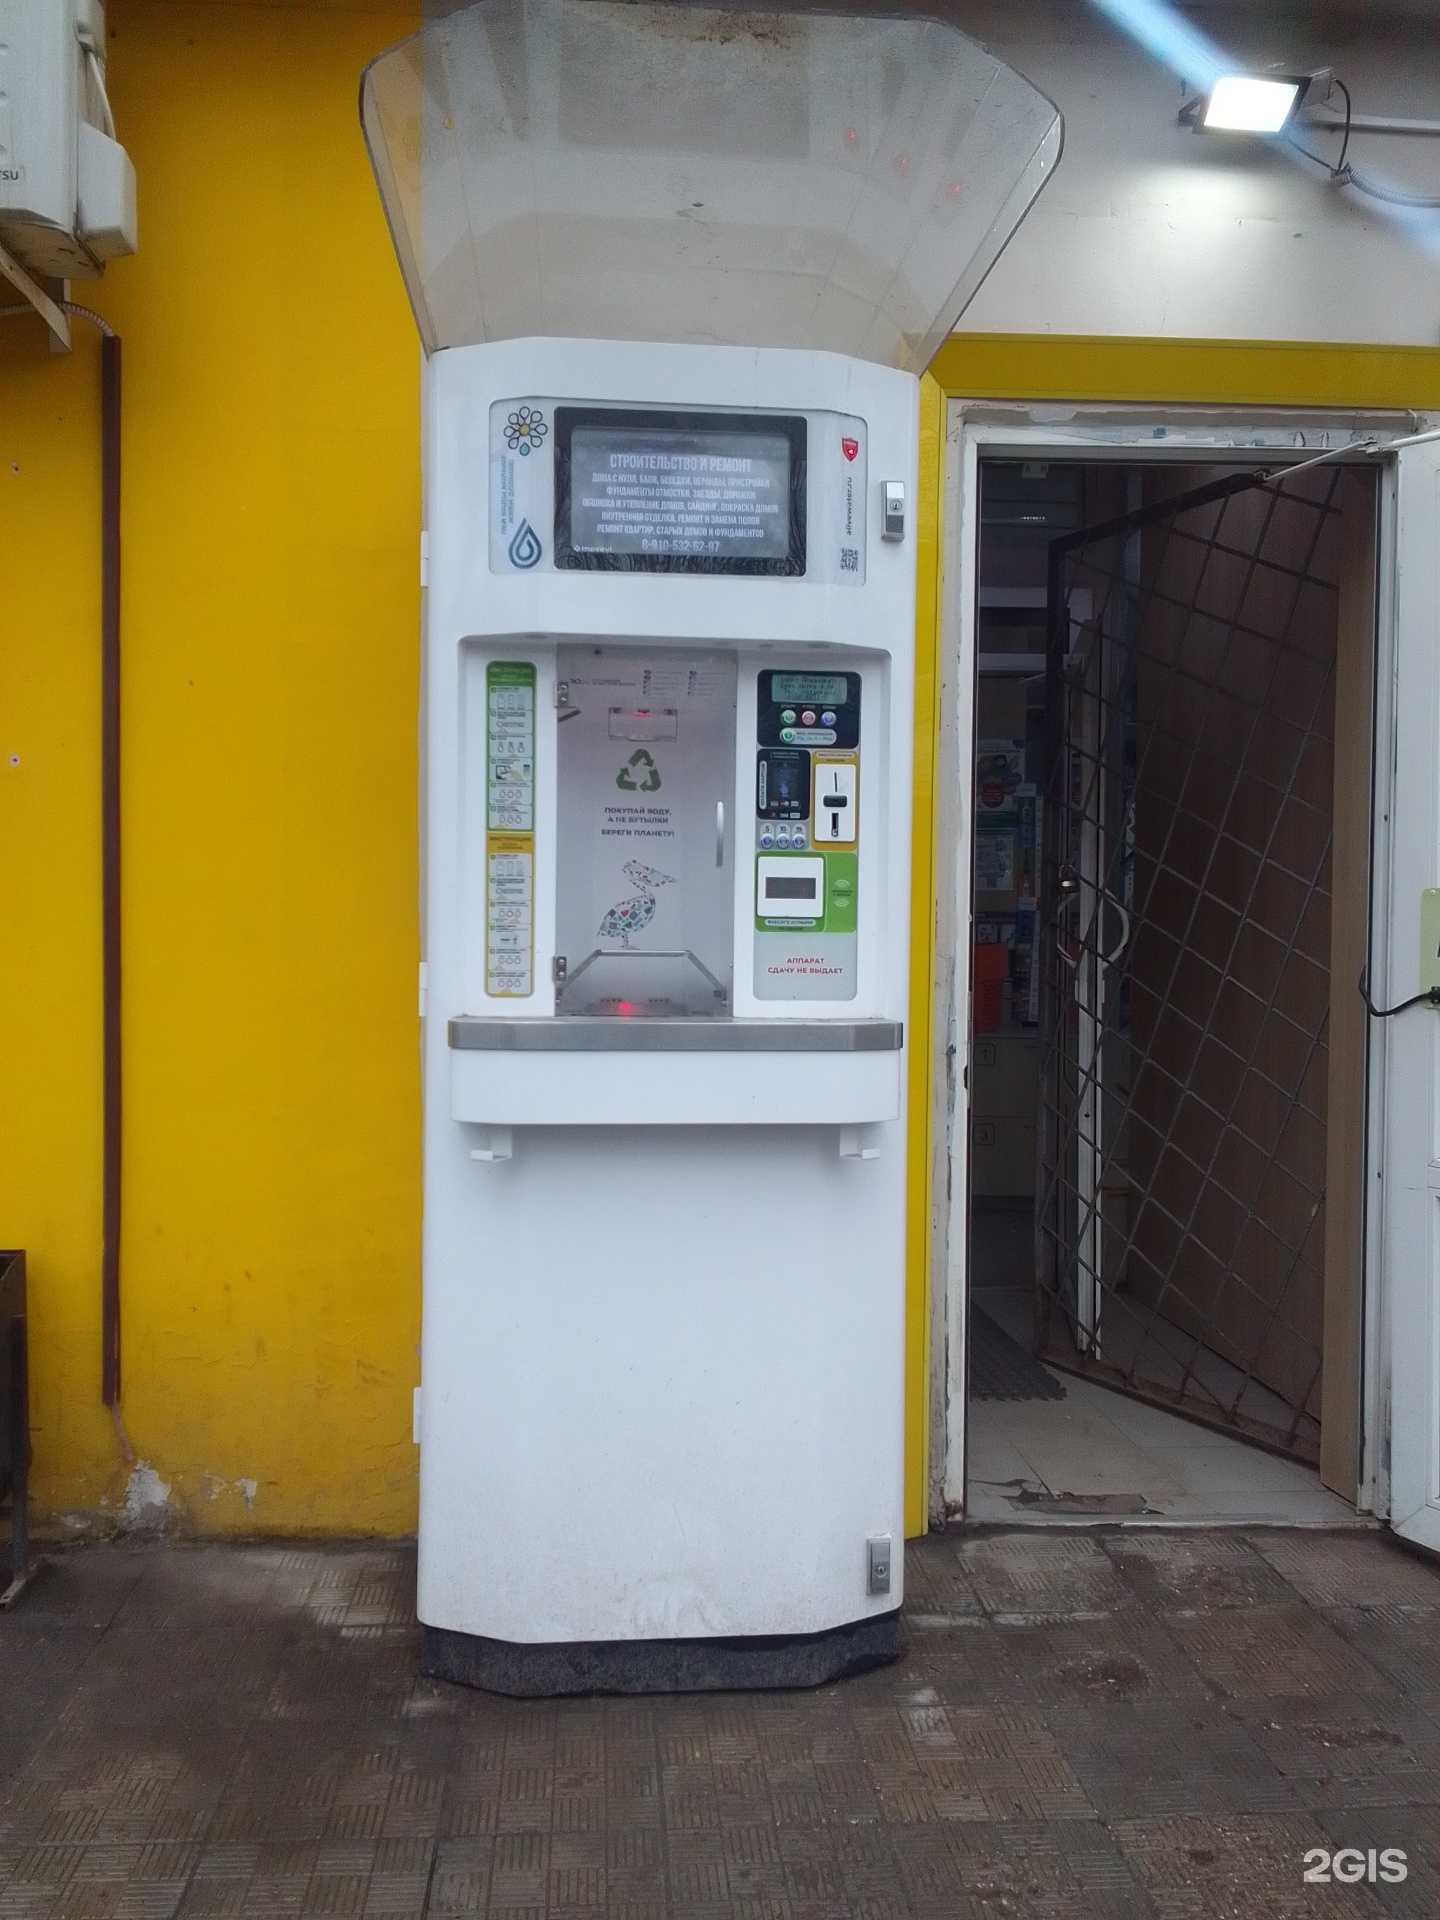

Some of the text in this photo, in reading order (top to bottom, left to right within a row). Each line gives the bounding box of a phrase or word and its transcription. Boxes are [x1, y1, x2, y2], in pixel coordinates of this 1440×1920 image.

[0, 170, 19, 181] SU
[610, 454, 753, 473] СТРОИТЕЛЬСТВО И РЕМОНТ
[604, 806, 646, 815] ПОКУПАЙ
[767, 966, 795, 974] СДАЧУ
